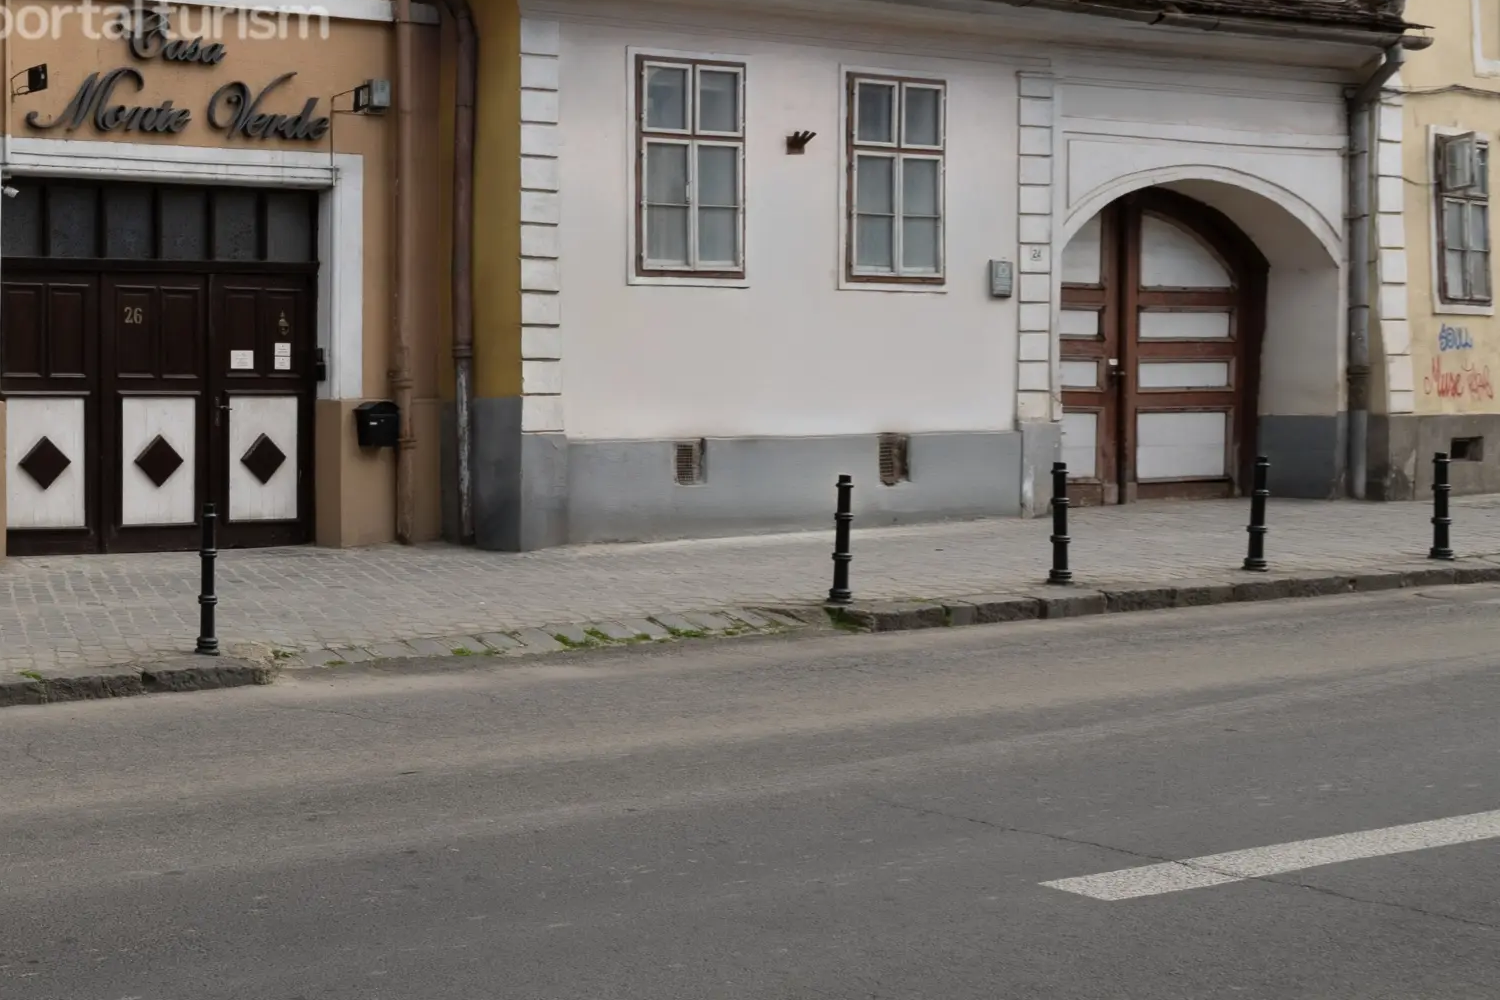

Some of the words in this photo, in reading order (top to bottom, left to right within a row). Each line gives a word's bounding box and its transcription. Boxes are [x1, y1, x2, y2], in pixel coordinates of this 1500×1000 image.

[113, 8, 227, 65] Casa
[25, 67, 192, 133] Monte
[206, 71, 330, 140] Verde
[124, 306, 143, 324] 26
